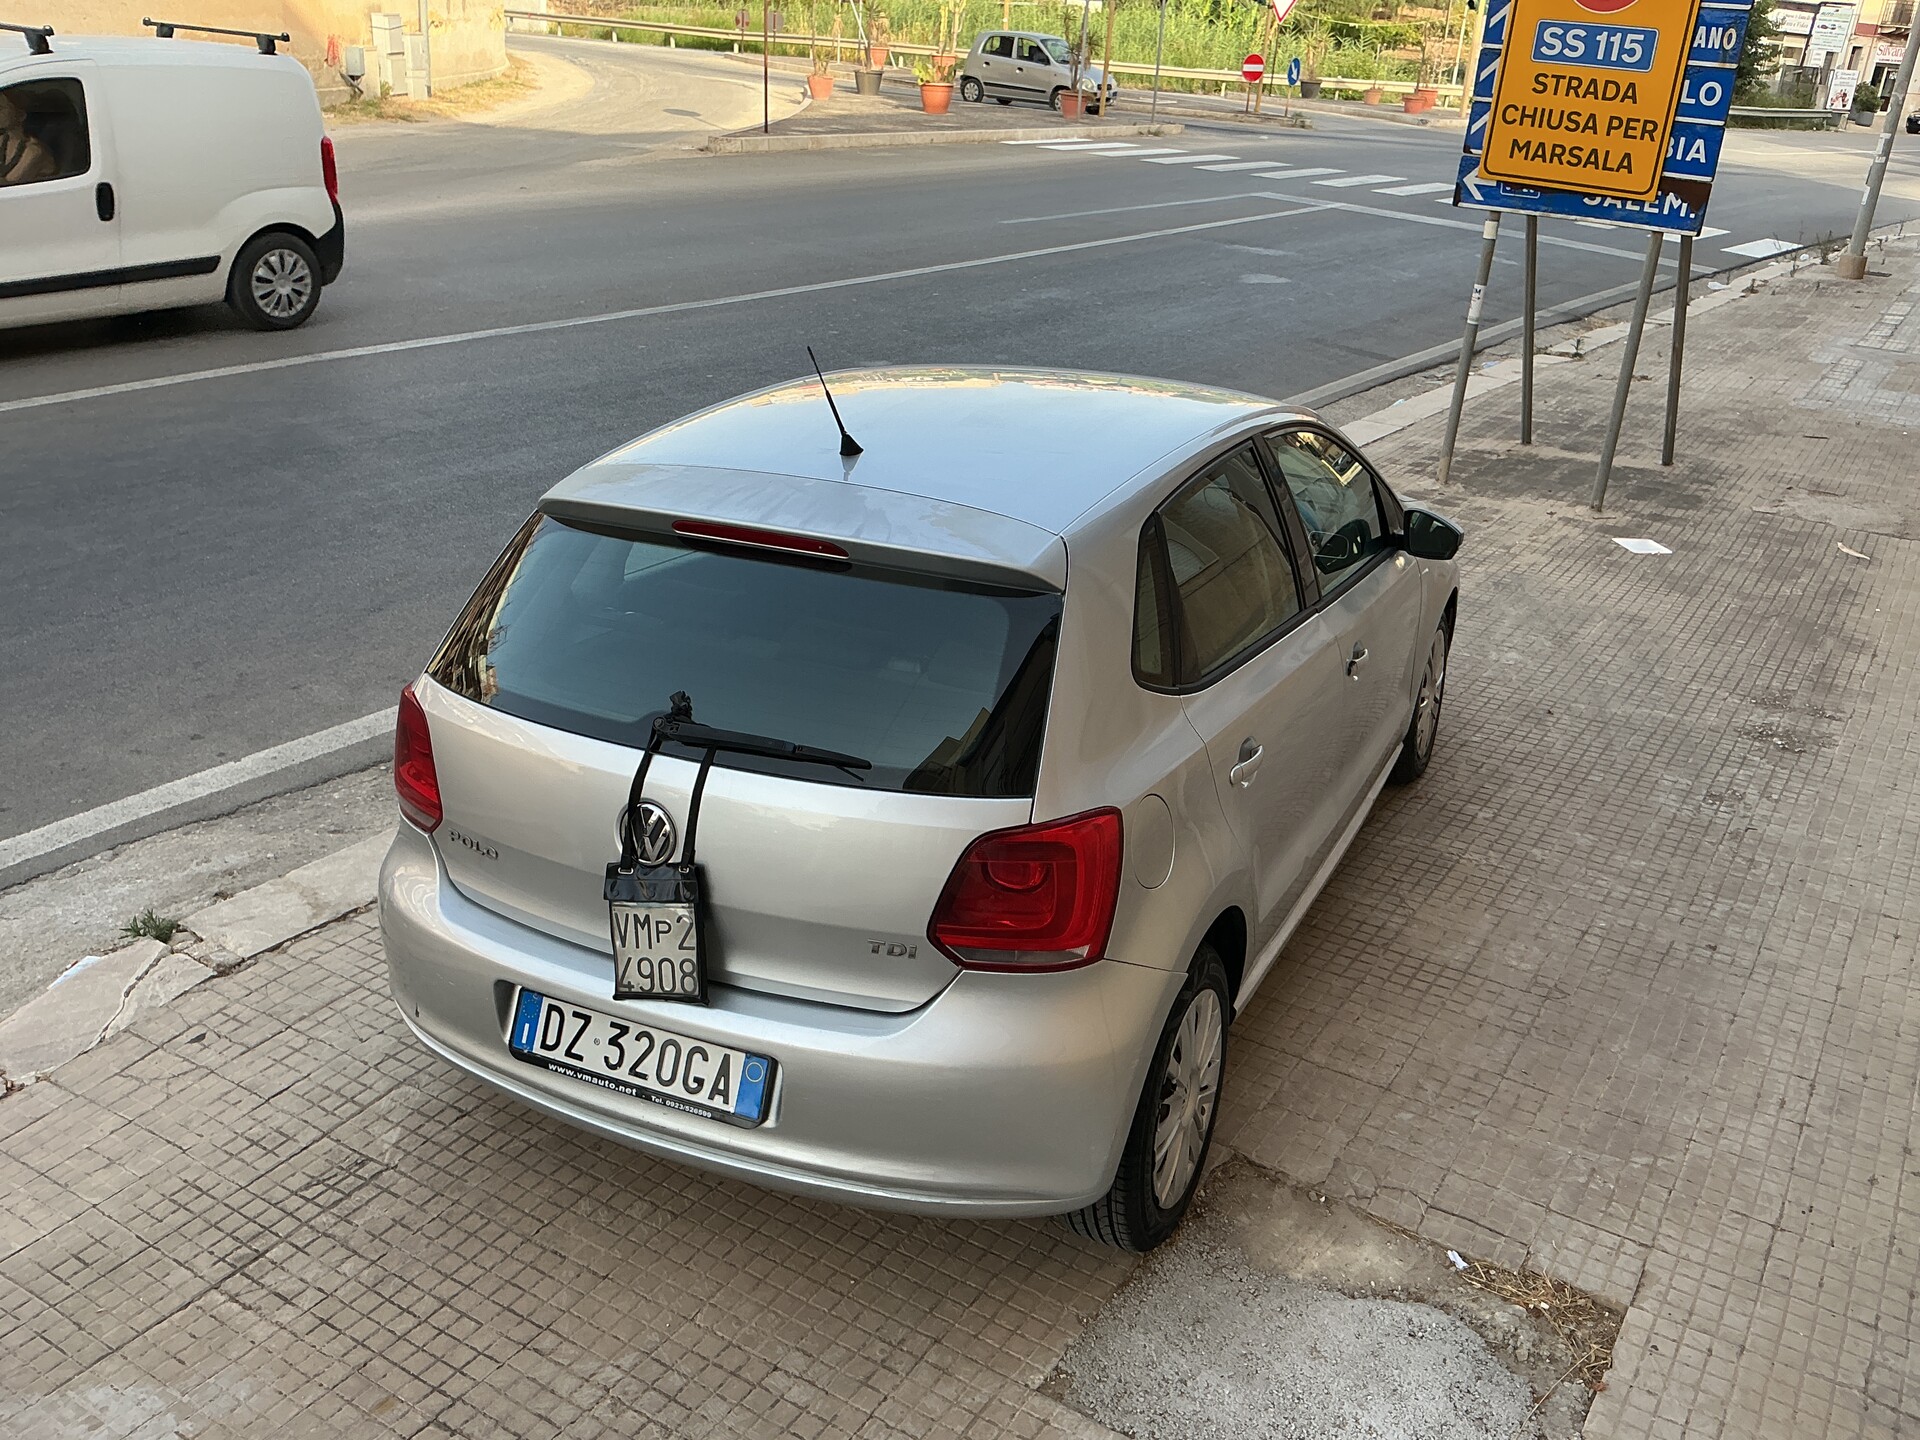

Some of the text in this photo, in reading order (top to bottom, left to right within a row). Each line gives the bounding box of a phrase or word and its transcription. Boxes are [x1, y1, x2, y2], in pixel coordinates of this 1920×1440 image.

[1540, 27, 1644, 63] SS 115
[1531, 72, 1639, 105] STRADA
[1501, 104, 1659, 142] CHIUSA PER
[1508, 138, 1634, 174] MARSALA
[447, 827, 499, 860] POLO
[866, 938, 918, 960] TDI
[618, 956, 698, 993] 4908
[539, 1002, 731, 1106] DZ 320GA
[548, 1063, 638, 1096] www.vmauto.net
[651, 1095, 664, 1105] Tel.
